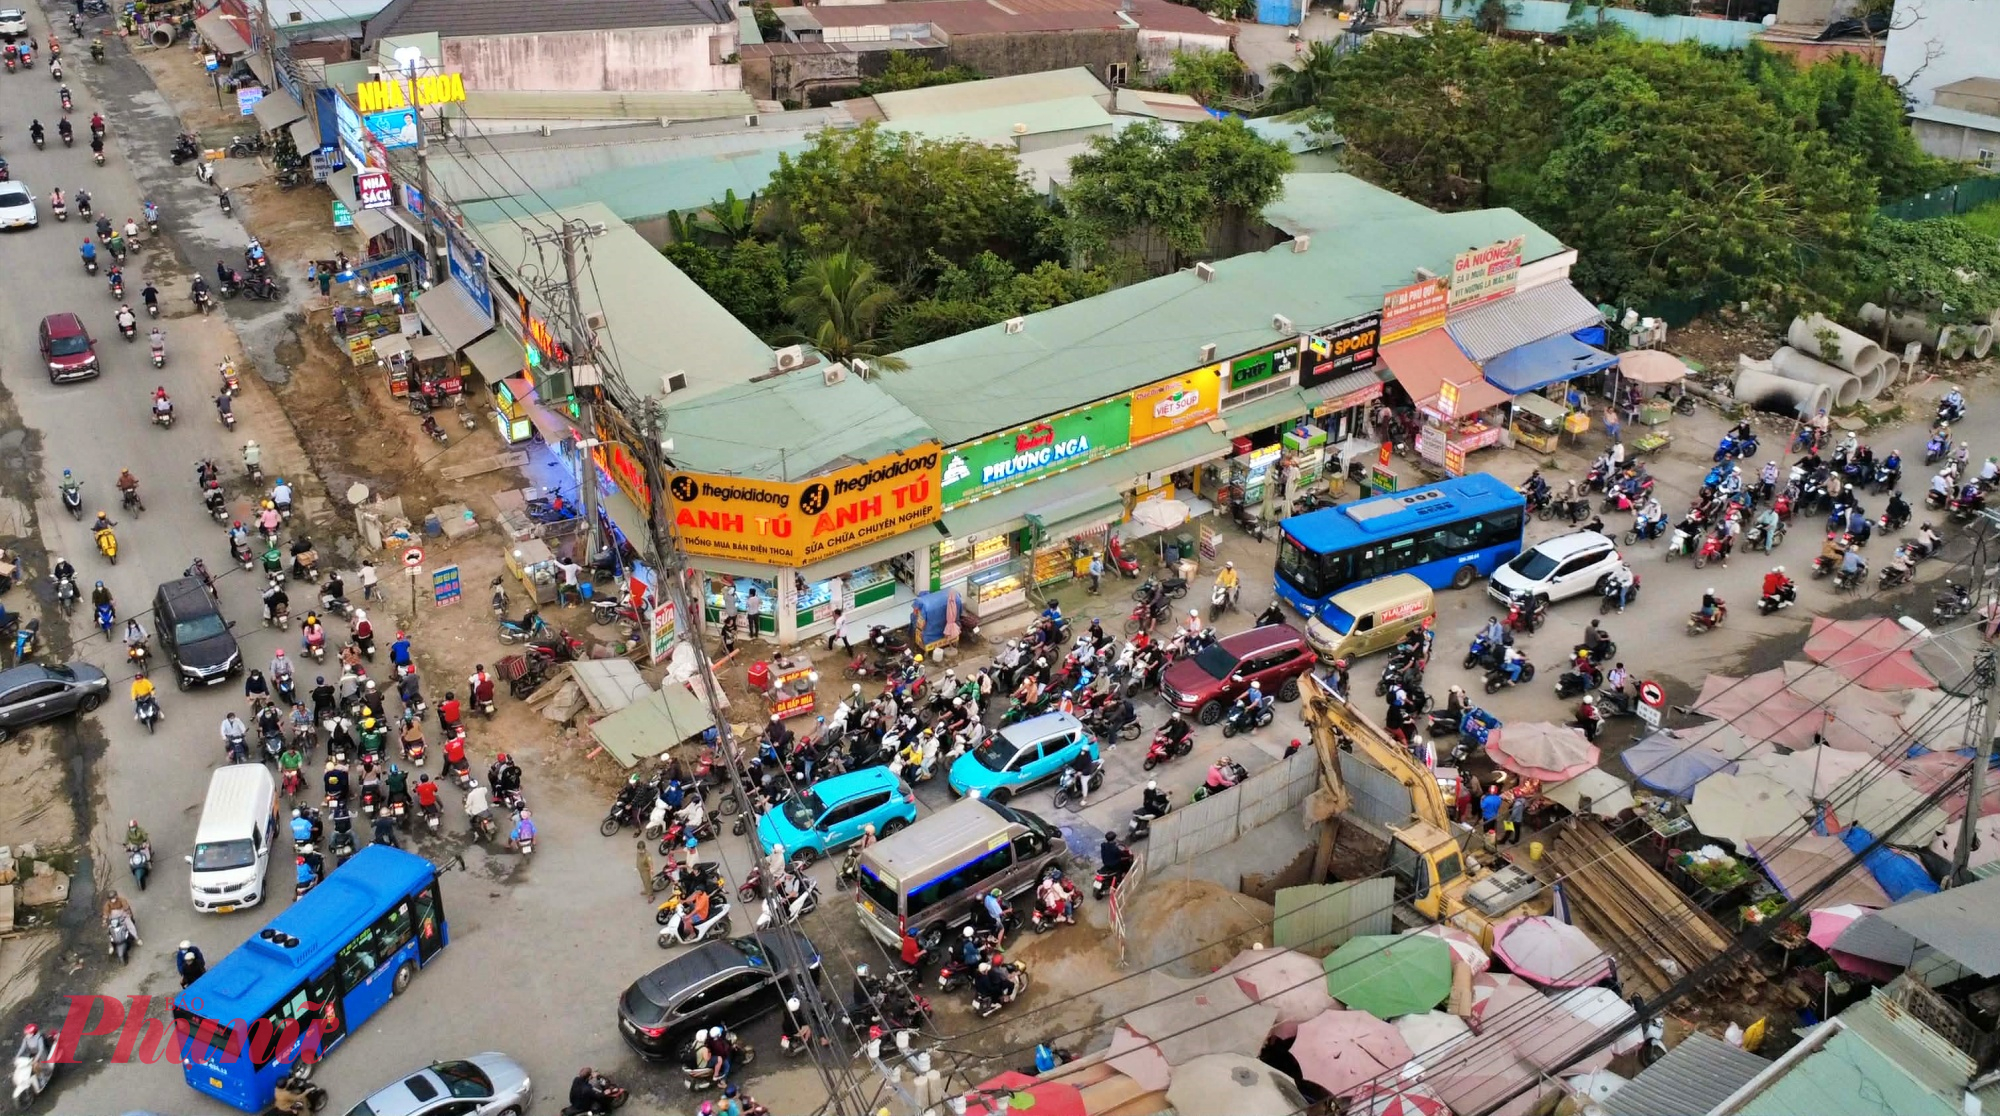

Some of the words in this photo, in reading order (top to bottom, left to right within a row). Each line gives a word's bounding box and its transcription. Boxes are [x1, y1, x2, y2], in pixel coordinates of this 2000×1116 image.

[357, 79, 405, 112] NHA
[361, 174, 387, 190] NHÀ
[361, 189, 392, 204] SÁCH
[1334, 329, 1377, 356] SPORT
[1176, 395, 1198, 411] SOUP
[982, 447, 1051, 484] PHƯƠNG
[1053, 434, 1090, 461] NGA
[834, 452, 938, 496] thegioididong
[702, 482, 790, 509] thegioididong
[812, 493, 882, 538] ANH
[891, 472, 930, 510] TÚ
[676, 507, 744, 534] ANH
[754, 512, 792, 539] TÚ
[857, 516, 896, 538] CHUYÊN
[898, 504, 934, 524] NGHIỆP
[713, 540, 731, 550] MUA
